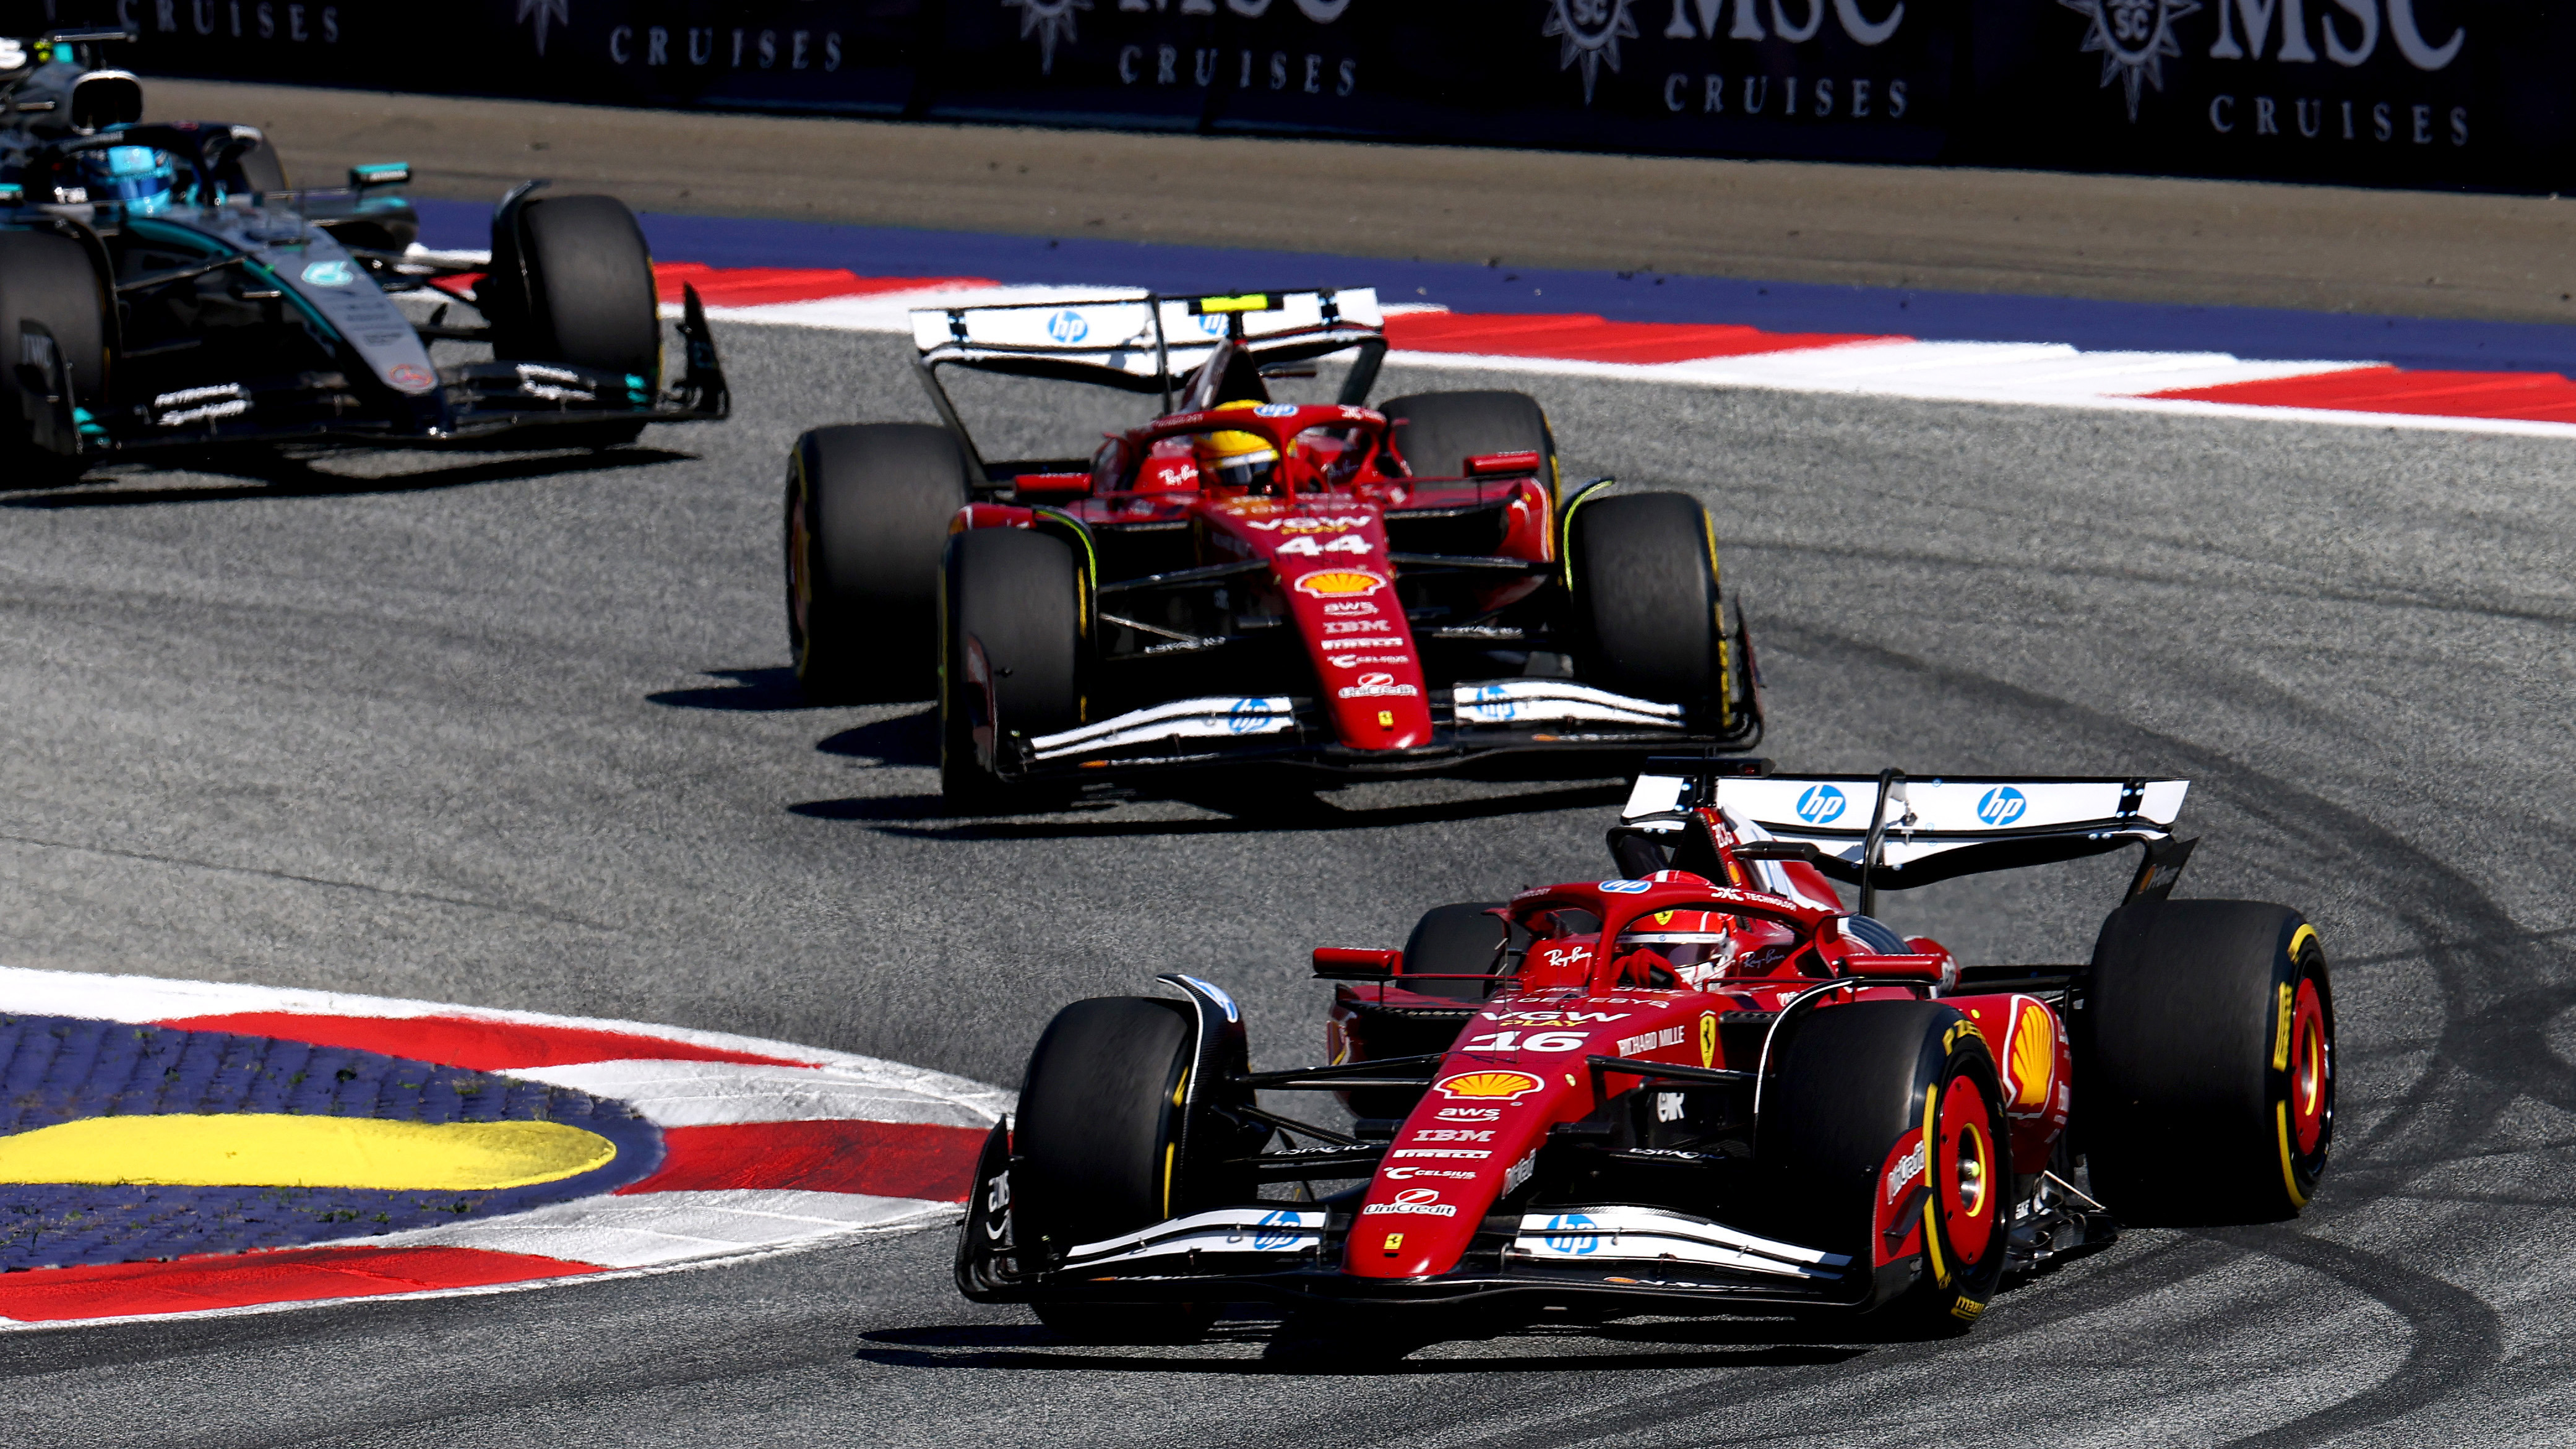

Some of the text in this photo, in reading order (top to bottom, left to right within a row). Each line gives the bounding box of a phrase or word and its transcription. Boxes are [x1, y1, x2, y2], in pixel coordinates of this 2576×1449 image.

[117, 0, 339, 43] CRUISES
[609, 24, 843, 72] CRUISES
[1119, 43, 1357, 97] CRUISES
[1663, 72, 1910, 118] CRUISES
[2208, 93, 2470, 147] CRUISES
[1051, 310, 1087, 343] hp
[1275, 534, 1374, 556] 44
[1324, 619, 1391, 634] IBM
[1799, 784, 1845, 824] hp
[1981, 785, 2025, 826] hp
[1517, 997, 1670, 1009] GEESYS
[1480, 1011, 1632, 1022] VGW
[1462, 1030, 1590, 1052] 16
[1658, 1024, 1685, 1047] MILLE
[1437, 1108, 1501, 1118] aws
[1411, 1129, 1496, 1142] IBM
[1392, 1148, 1493, 1159] PIRELLI
[1414, 1169, 1476, 1178] CELSIUS
[1364, 1203, 1456, 1217] UniCredit
[1255, 1209, 1299, 1251] hp
[1547, 1214, 1596, 1255] hp
